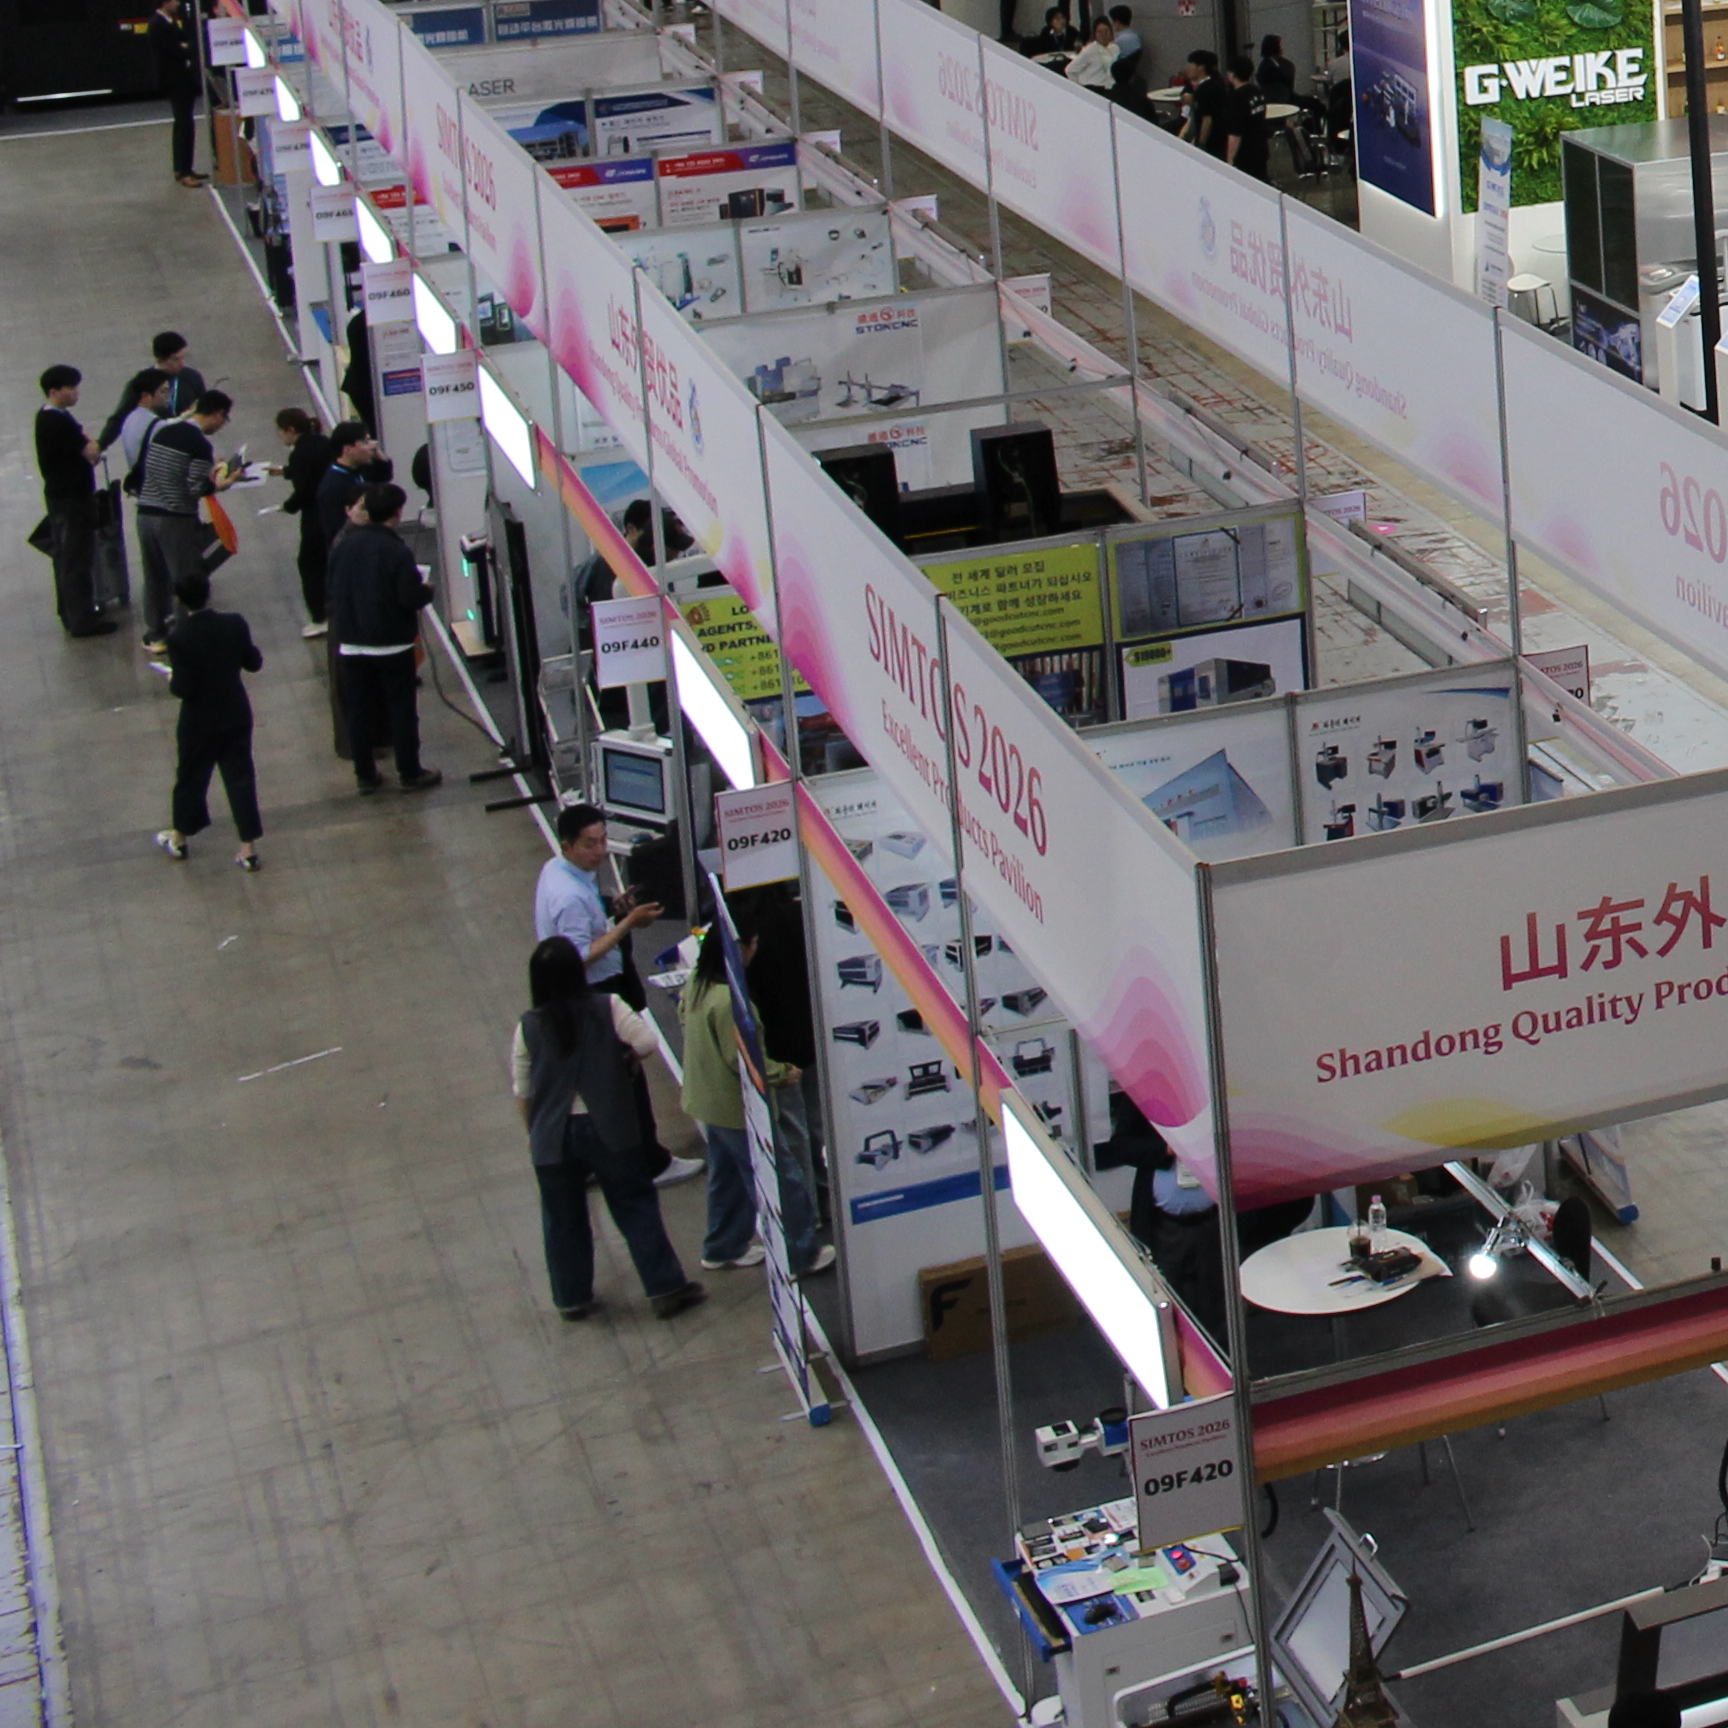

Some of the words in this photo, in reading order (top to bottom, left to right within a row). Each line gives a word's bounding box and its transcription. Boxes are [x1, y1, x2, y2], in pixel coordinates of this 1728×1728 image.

[1570, 82, 1647, 109] LASER
[1022, 560, 1045, 575] 모집
[996, 575, 1043, 594] 파트너가
[996, 597, 1021, 612] 함께
[1024, 589, 1083, 609] 성장하세요
[600, 635, 660, 655] 09F440
[1561, 660, 1584, 672] 2026
[864, 582, 972, 767] SIMTOS
[977, 702, 1049, 858] 2026
[723, 803, 765, 818] SIMTOS
[765, 799, 790, 811] 2026
[880, 698, 932, 798] Excellent
[989, 832, 1045, 926] Pavilion
[727, 827, 792, 852] 09F420
[1315, 1016, 1504, 1086] Shandong
[1510, 987, 1646, 1045] Quality
[1140, 1427, 1196, 1451] SIMTOS
[1197, 1418, 1231, 1436] 2026
[1144, 1459, 1234, 1497] 09F420
